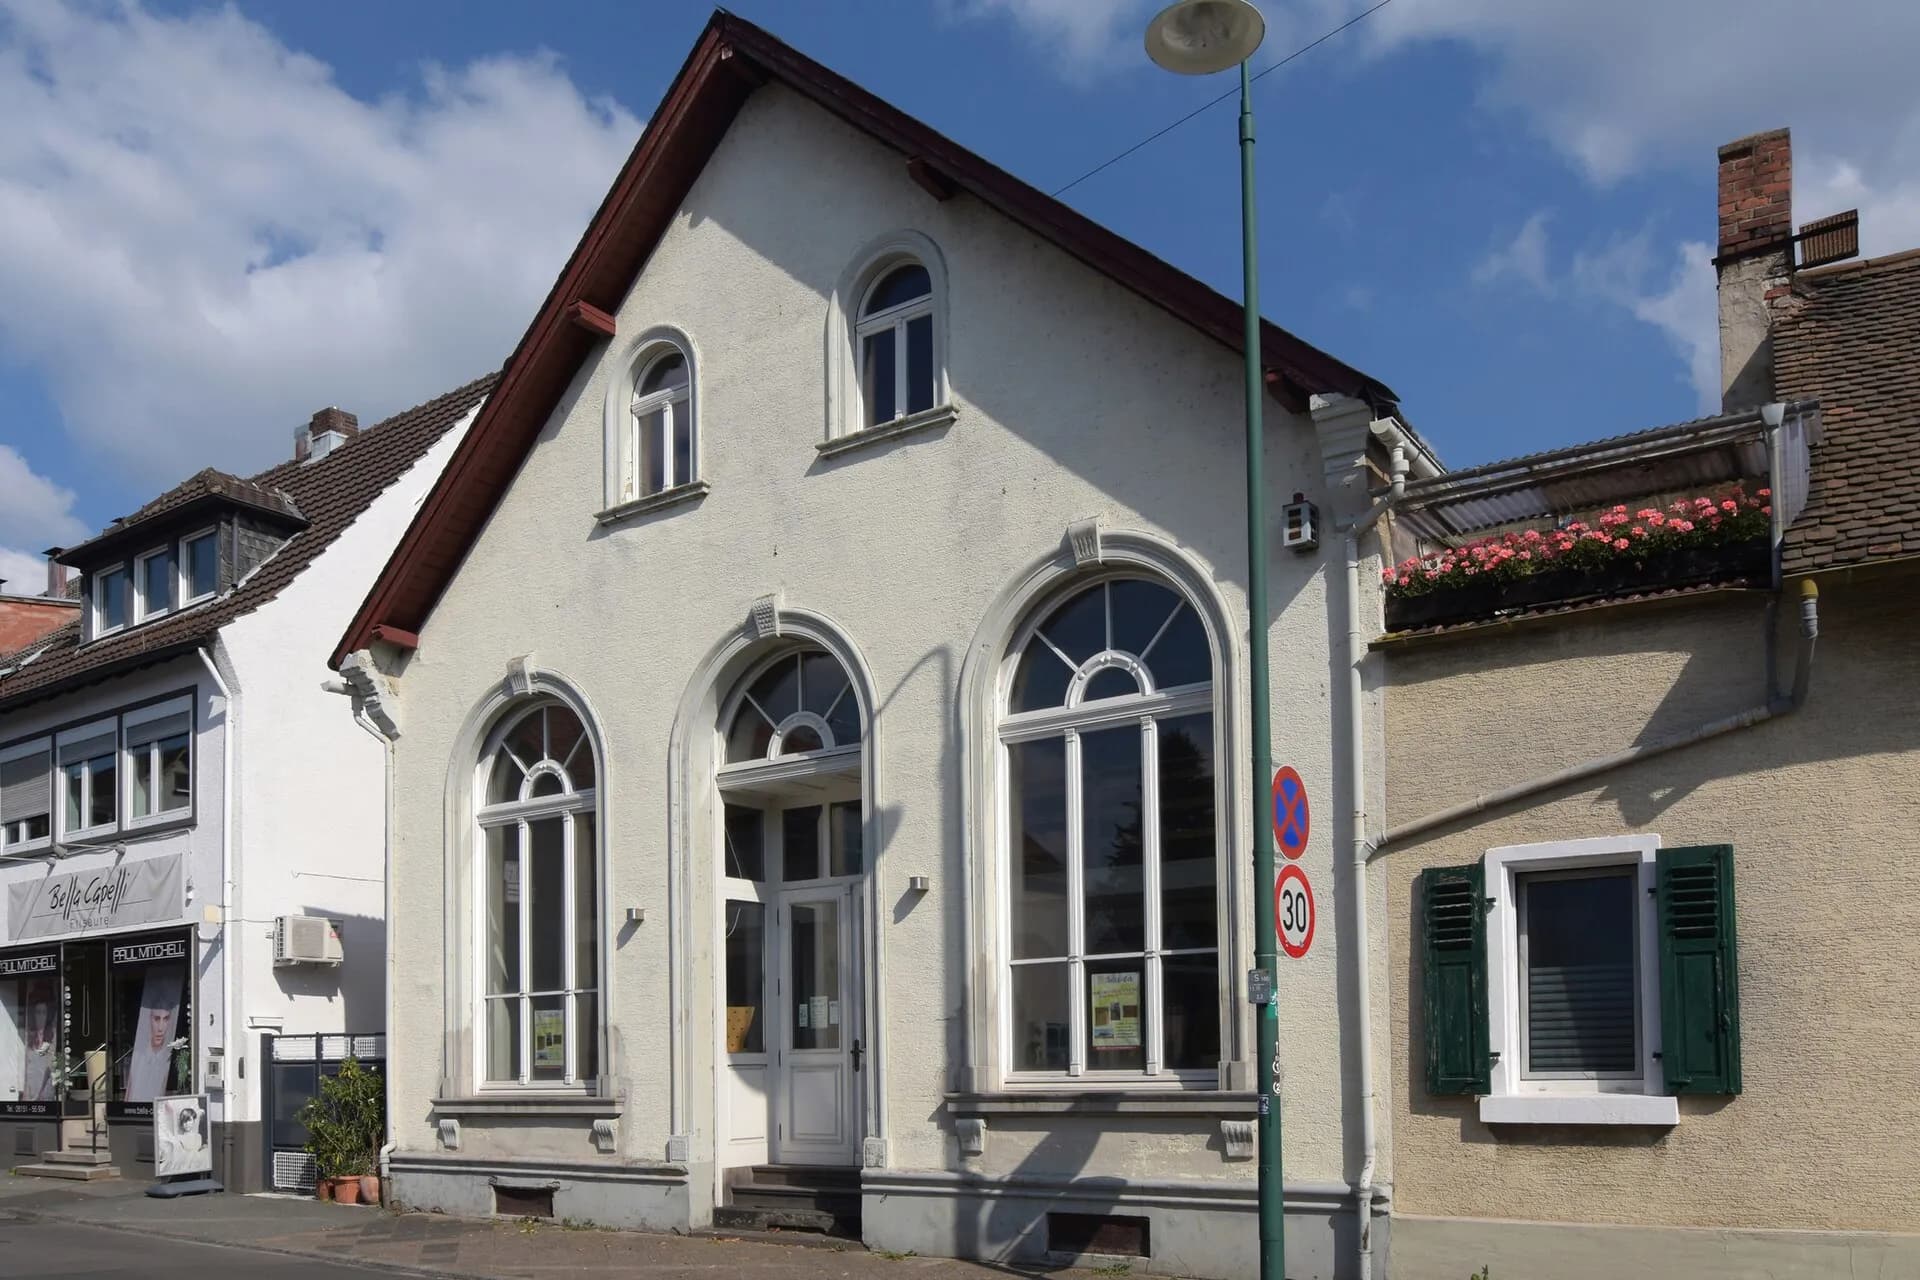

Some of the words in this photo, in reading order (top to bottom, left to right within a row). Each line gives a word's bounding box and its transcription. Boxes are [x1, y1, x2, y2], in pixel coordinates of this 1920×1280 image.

[48, 876, 81, 920] Bella
[84, 867, 129, 914] Capelli
[1283, 889, 1306, 932] 30
[0, 961, 17, 973] AUL
[17, 957, 57, 971] MITCHELL
[113, 948, 138, 961] PAUL
[138, 943, 185, 958] MITCHELL
